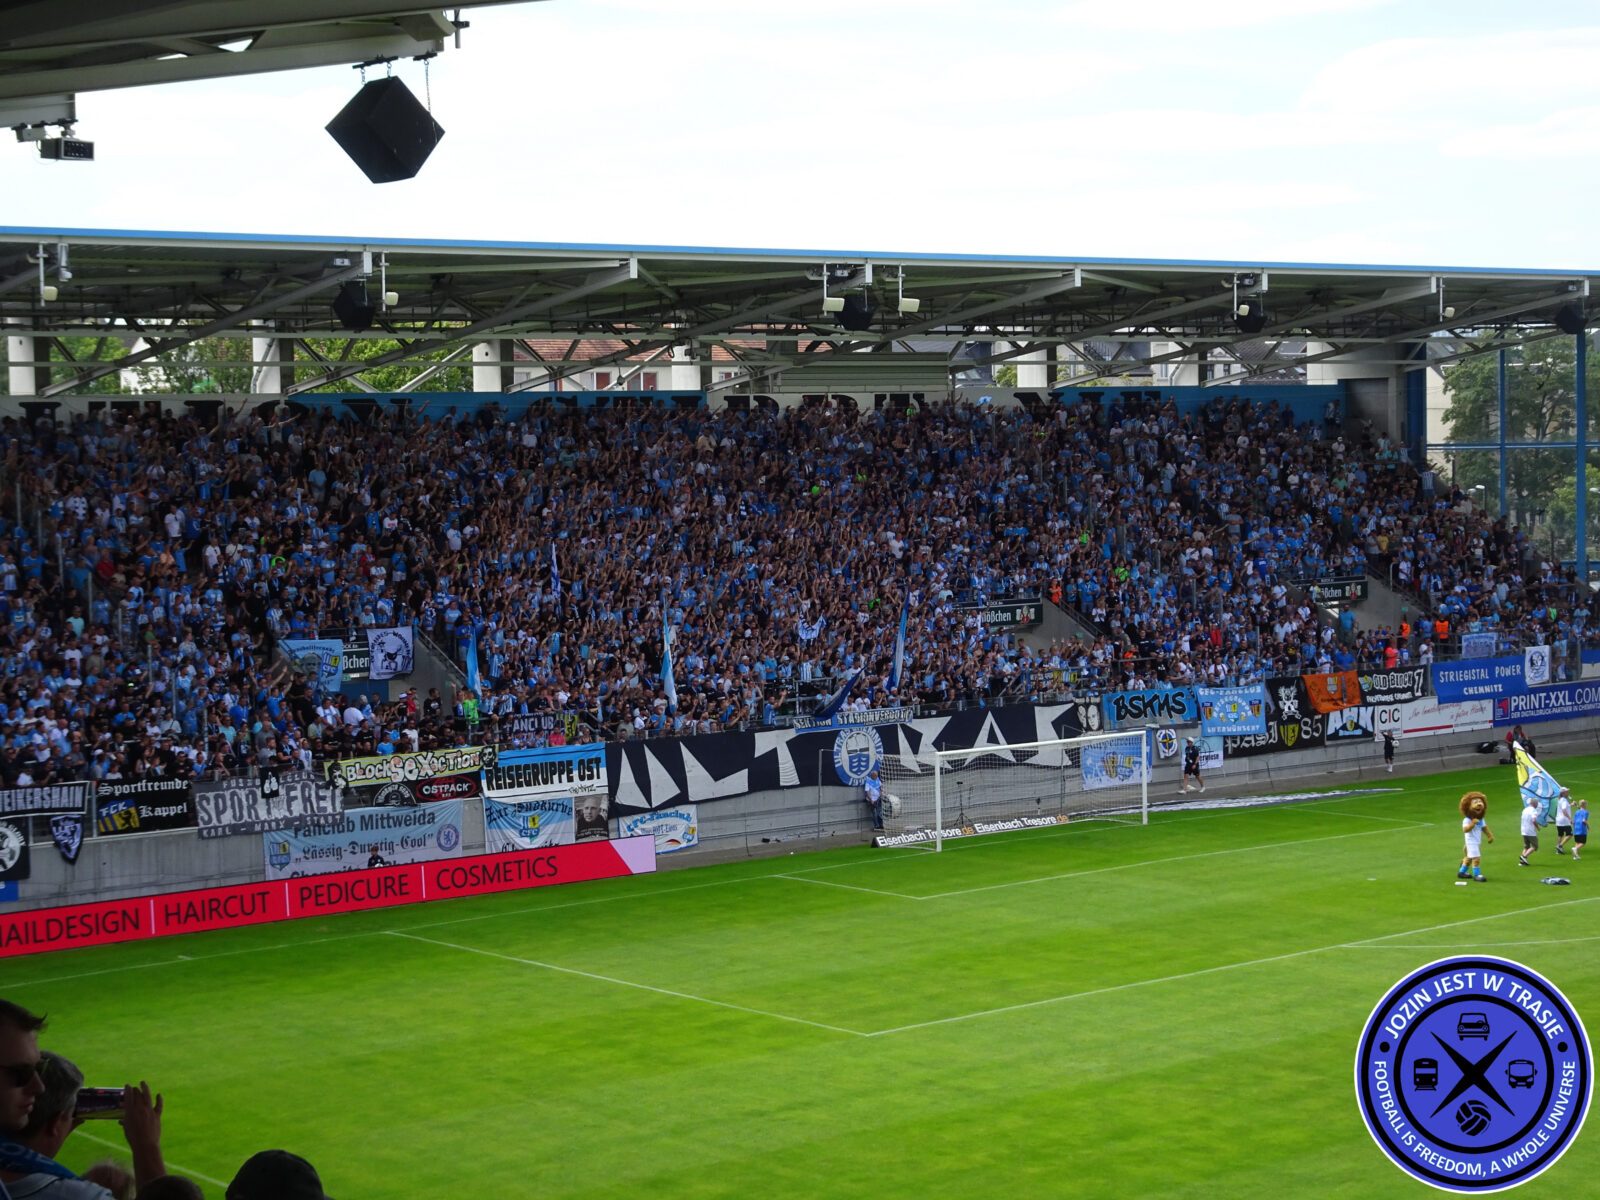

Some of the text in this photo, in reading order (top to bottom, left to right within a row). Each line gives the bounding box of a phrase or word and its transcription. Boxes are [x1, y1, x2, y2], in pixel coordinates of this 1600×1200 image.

[1439, 664, 1521, 683] STRIEGISTAL POWER
[1463, 684, 1503, 695] CHEMNITZ
[1113, 691, 1187, 721] BSKMS
[1379, 707, 1400, 724] CIC
[484, 757, 601, 791] REISEGRUPPE OST
[422, 783, 470, 795] OSTPACK
[138, 802, 188, 819] Kappel
[360, 809, 436, 832] Mittweida
[975, 819, 1023, 833] Eisenbach
[876, 830, 927, 847] Eisenbach
[164, 890, 270, 926] HAIRCUT
[300, 873, 409, 908] PEDICURE
[436, 855, 558, 889] COSMETICS
